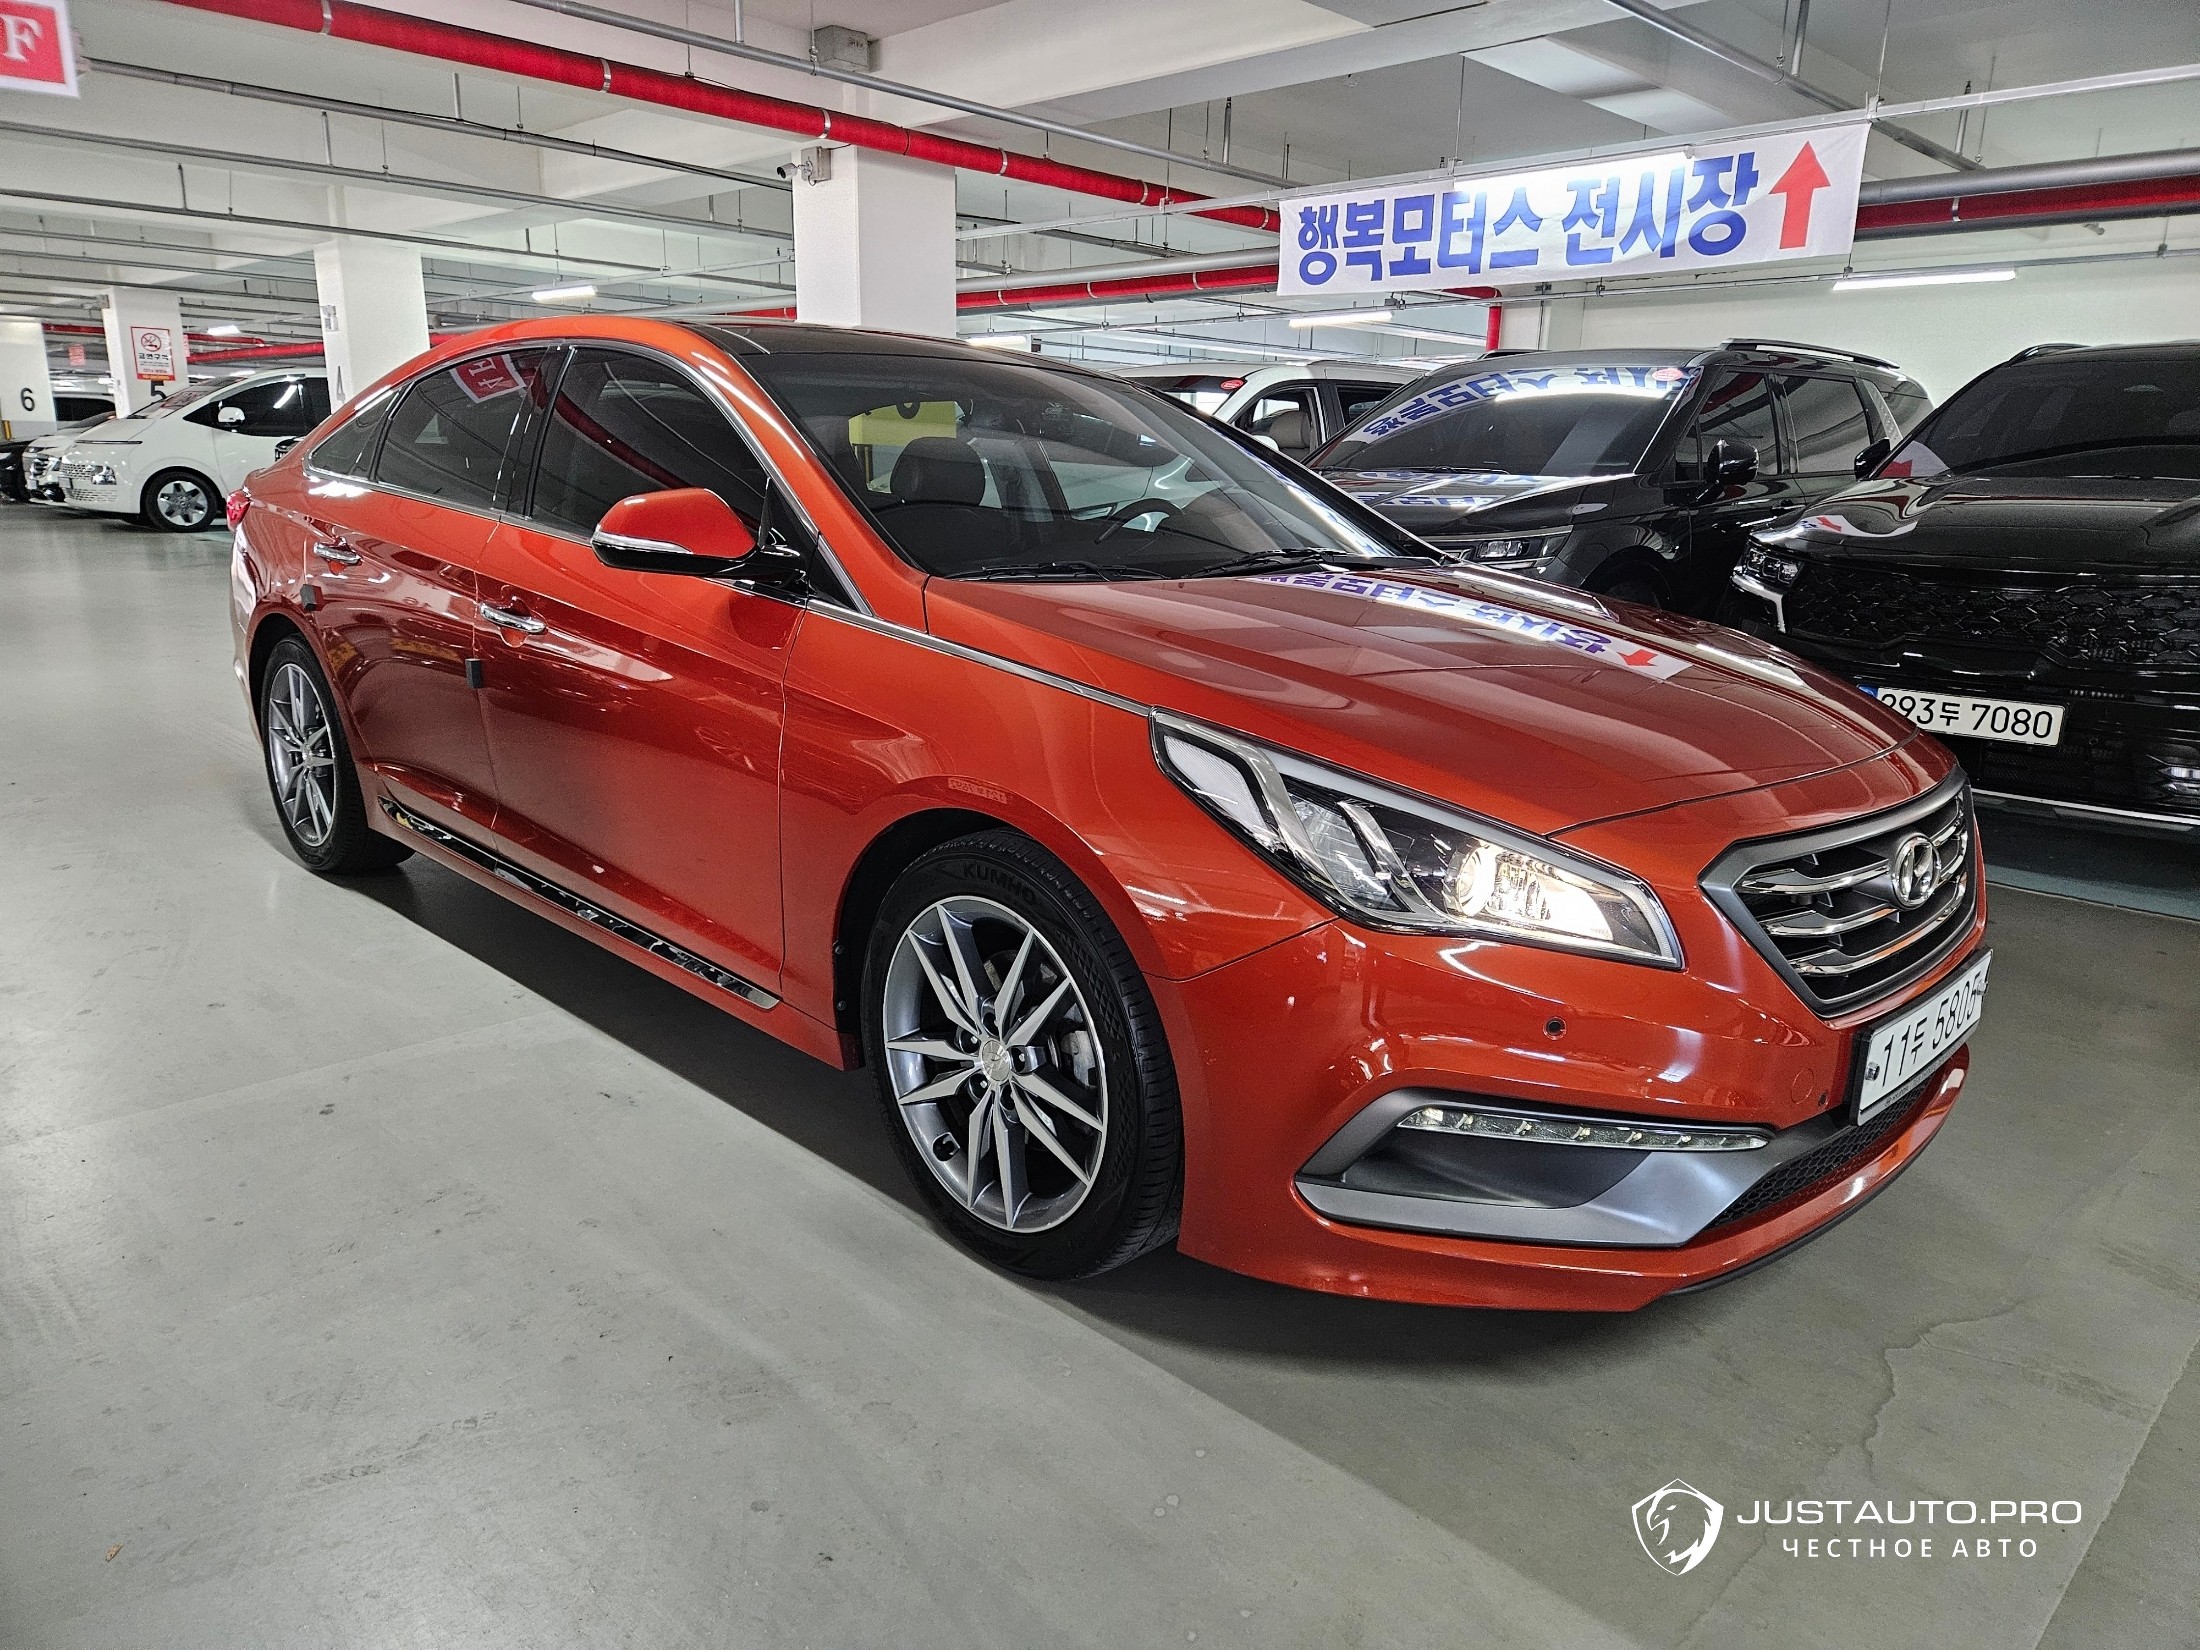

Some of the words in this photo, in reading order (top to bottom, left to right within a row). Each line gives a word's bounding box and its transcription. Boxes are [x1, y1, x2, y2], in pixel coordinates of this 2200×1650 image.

[0, 14, 43, 62] F
[1299, 186, 1543, 286] 행복모터스
[1562, 152, 1759, 267] 전시장
[20, 388, 36, 411] 6
[1971, 703, 2053, 738] 7080
[963, 864, 1036, 904] KUMHO
[1883, 1017, 1928, 1087] 11두
